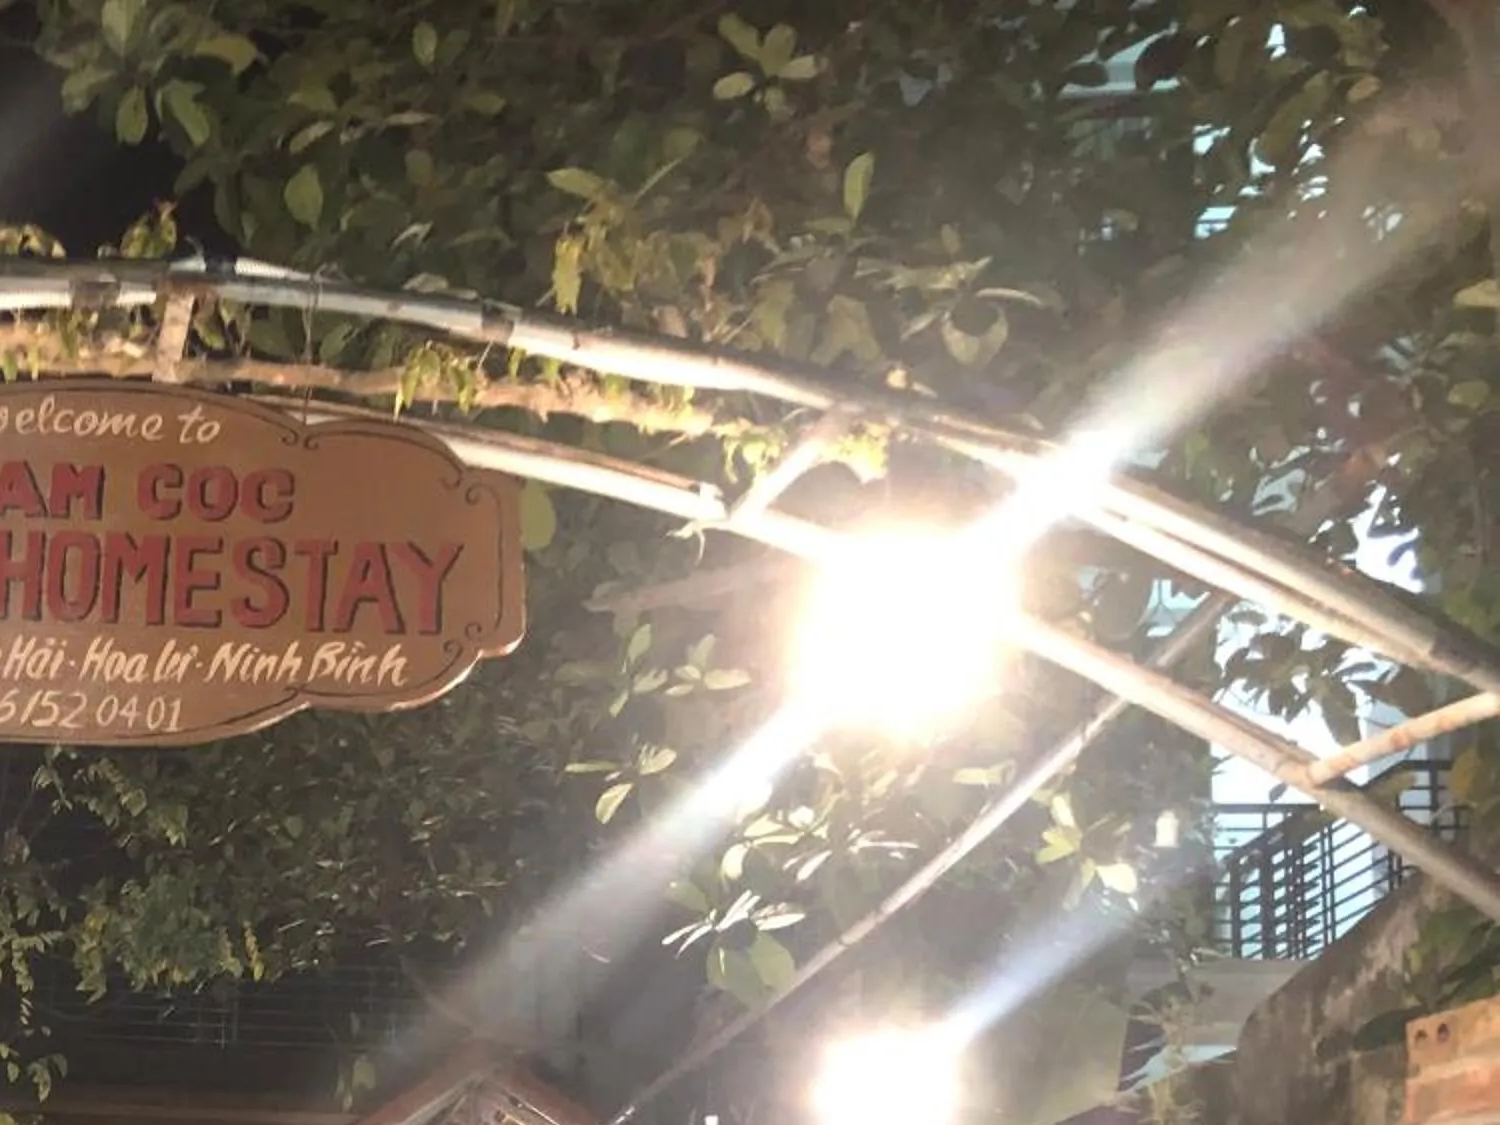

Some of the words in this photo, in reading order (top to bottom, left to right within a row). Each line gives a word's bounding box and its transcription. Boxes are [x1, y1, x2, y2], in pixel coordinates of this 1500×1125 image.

[178, 402, 221, 444] to
[137, 463, 296, 523] COC
[79, 635, 149, 684] Hoa
[203, 639, 303, 686] Ninh
[307, 640, 409, 687] Bình
